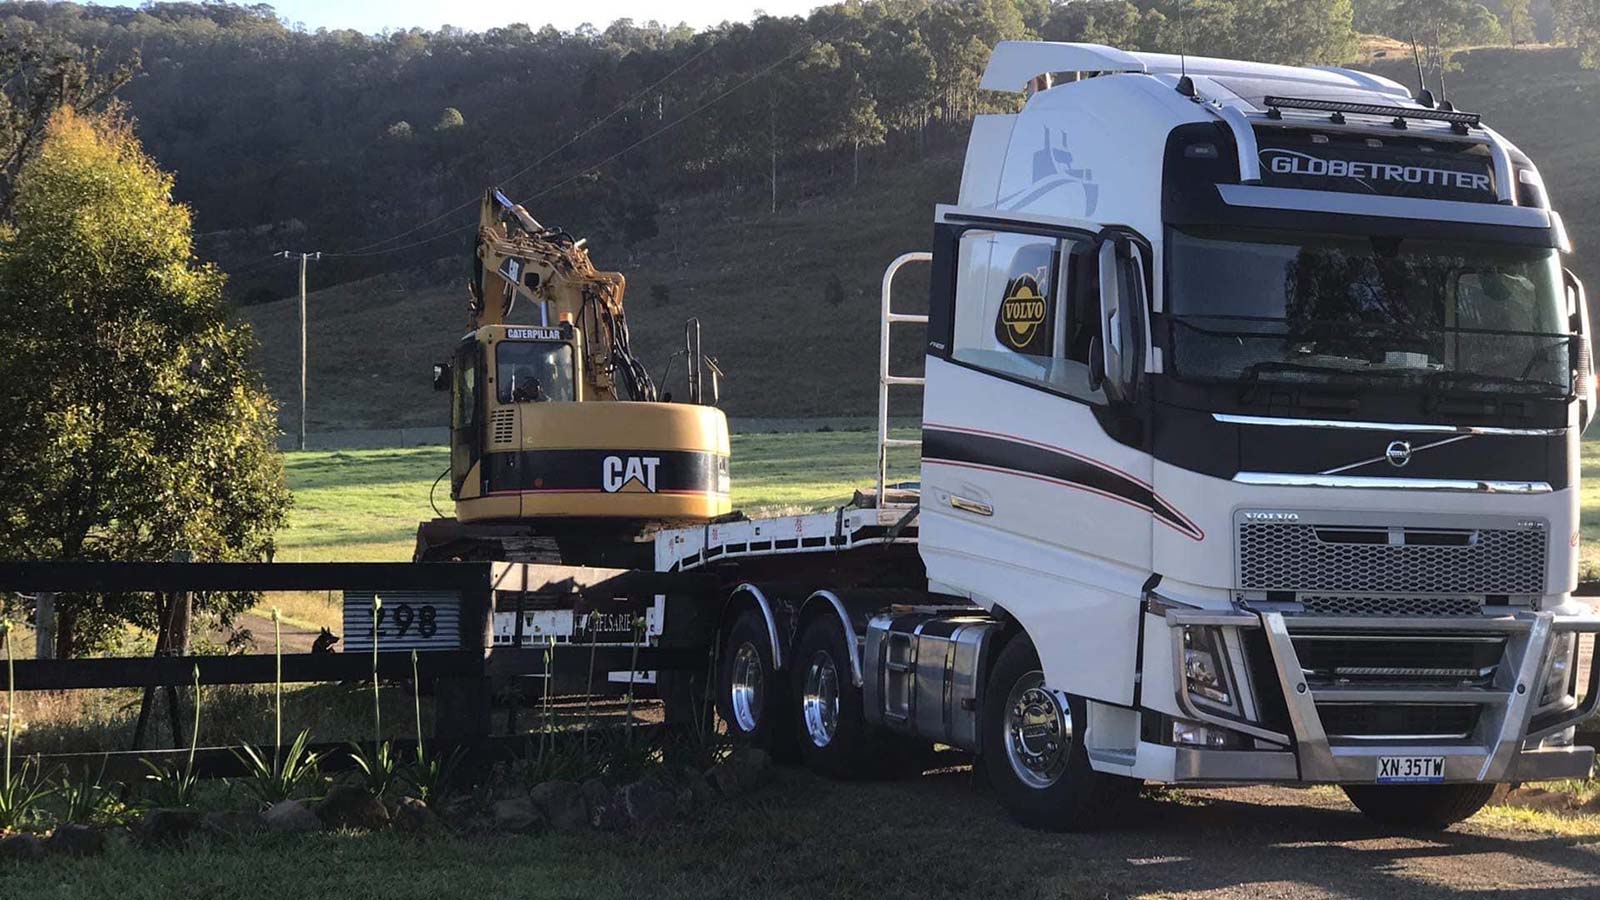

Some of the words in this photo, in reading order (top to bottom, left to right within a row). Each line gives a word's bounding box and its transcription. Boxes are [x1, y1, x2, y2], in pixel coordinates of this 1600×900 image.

[1271, 156, 1490, 191] GLOBETROTTER
[1005, 301, 1044, 319] VOLVO
[507, 328, 560, 340] CATERPILLAR
[603, 456, 661, 493] CAT
[367, 603, 437, 639] 298
